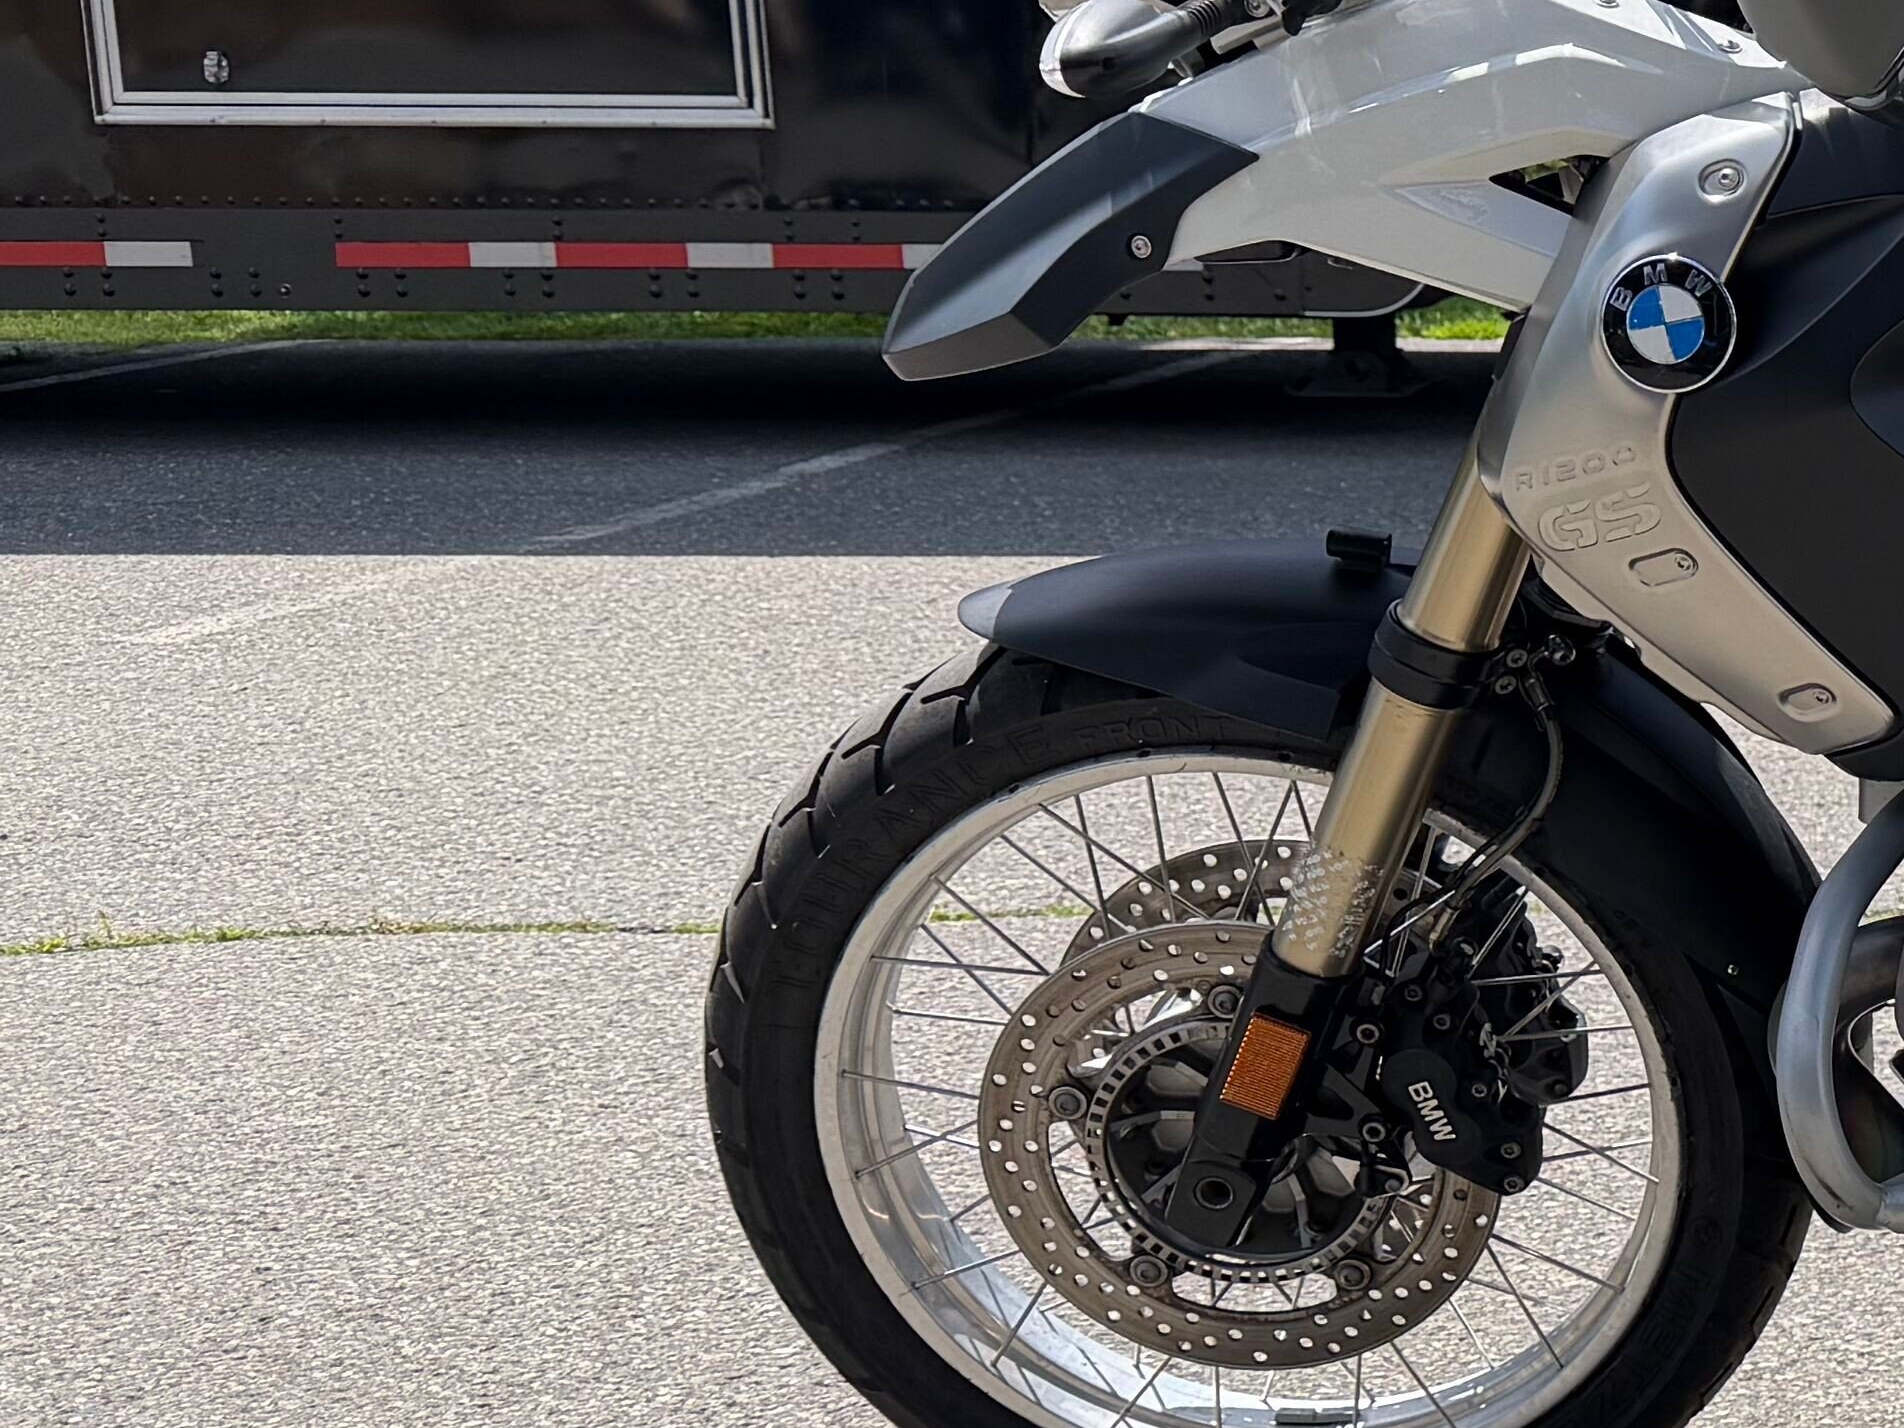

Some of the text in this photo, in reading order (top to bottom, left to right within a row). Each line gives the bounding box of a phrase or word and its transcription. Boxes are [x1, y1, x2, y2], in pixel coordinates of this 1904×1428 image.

[1609, 262, 1714, 312] BMW
[1514, 444, 1638, 492] R1200
[1537, 483, 1663, 552] GS
[1407, 1080, 1457, 1142] BMW
